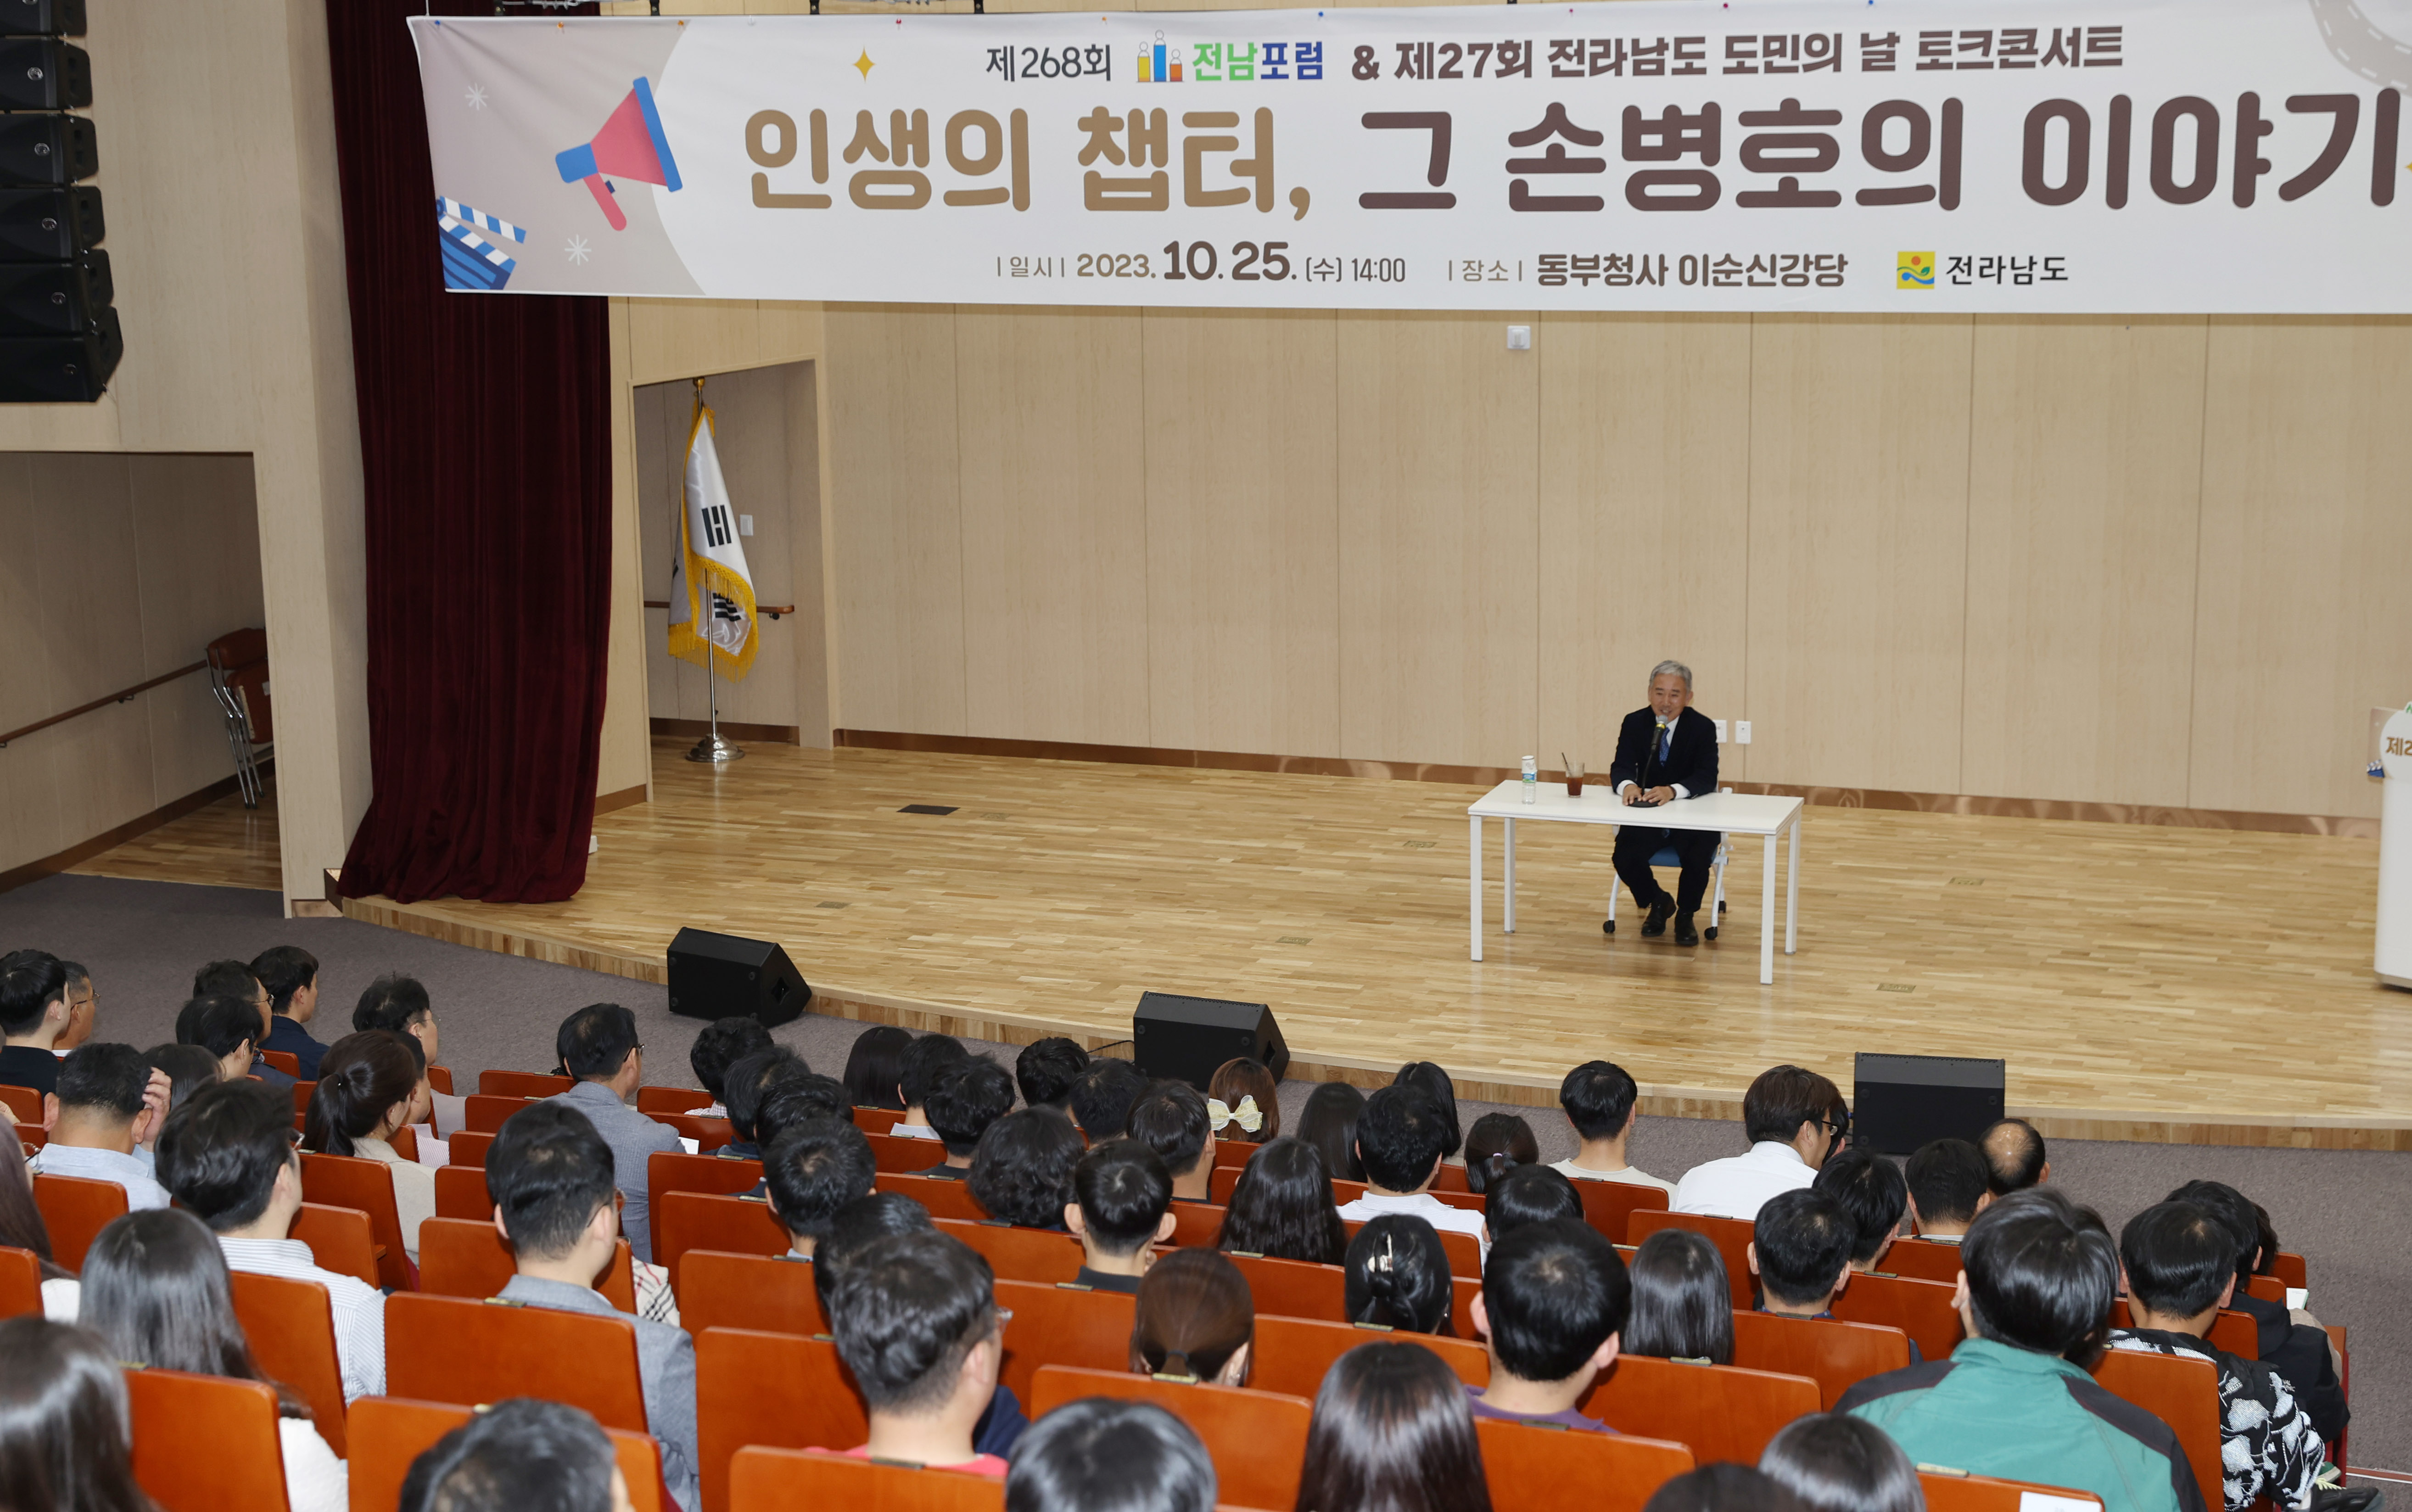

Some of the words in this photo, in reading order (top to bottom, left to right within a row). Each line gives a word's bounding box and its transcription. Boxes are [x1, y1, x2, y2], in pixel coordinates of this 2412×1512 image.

[985, 43, 1111, 83] 제268회
[1192, 40, 1323, 82] 전남포럼
[1351, 44, 1380, 81] &
[1393, 39, 1533, 80] 제27회
[1547, 35, 1707, 78] 전라남도
[1722, 32, 1843, 75] 도민의
[1859, 31, 1901, 73] 날
[1915, 25, 2123, 72] 토크콘서트
[744, 107, 1031, 213] 인생의
[1077, 106, 1311, 222] 챕터,
[1358, 111, 1457, 210] 그
[1505, 96, 1964, 213] 손병호의
[2021, 85, 2401, 211] 이야기
[1351, 257, 1406, 283] 14:00
[1537, 252, 1670, 287] 동부청사
[1678, 252, 1849, 287] 이순신강당
[1946, 255, 2069, 286] 전라남도
